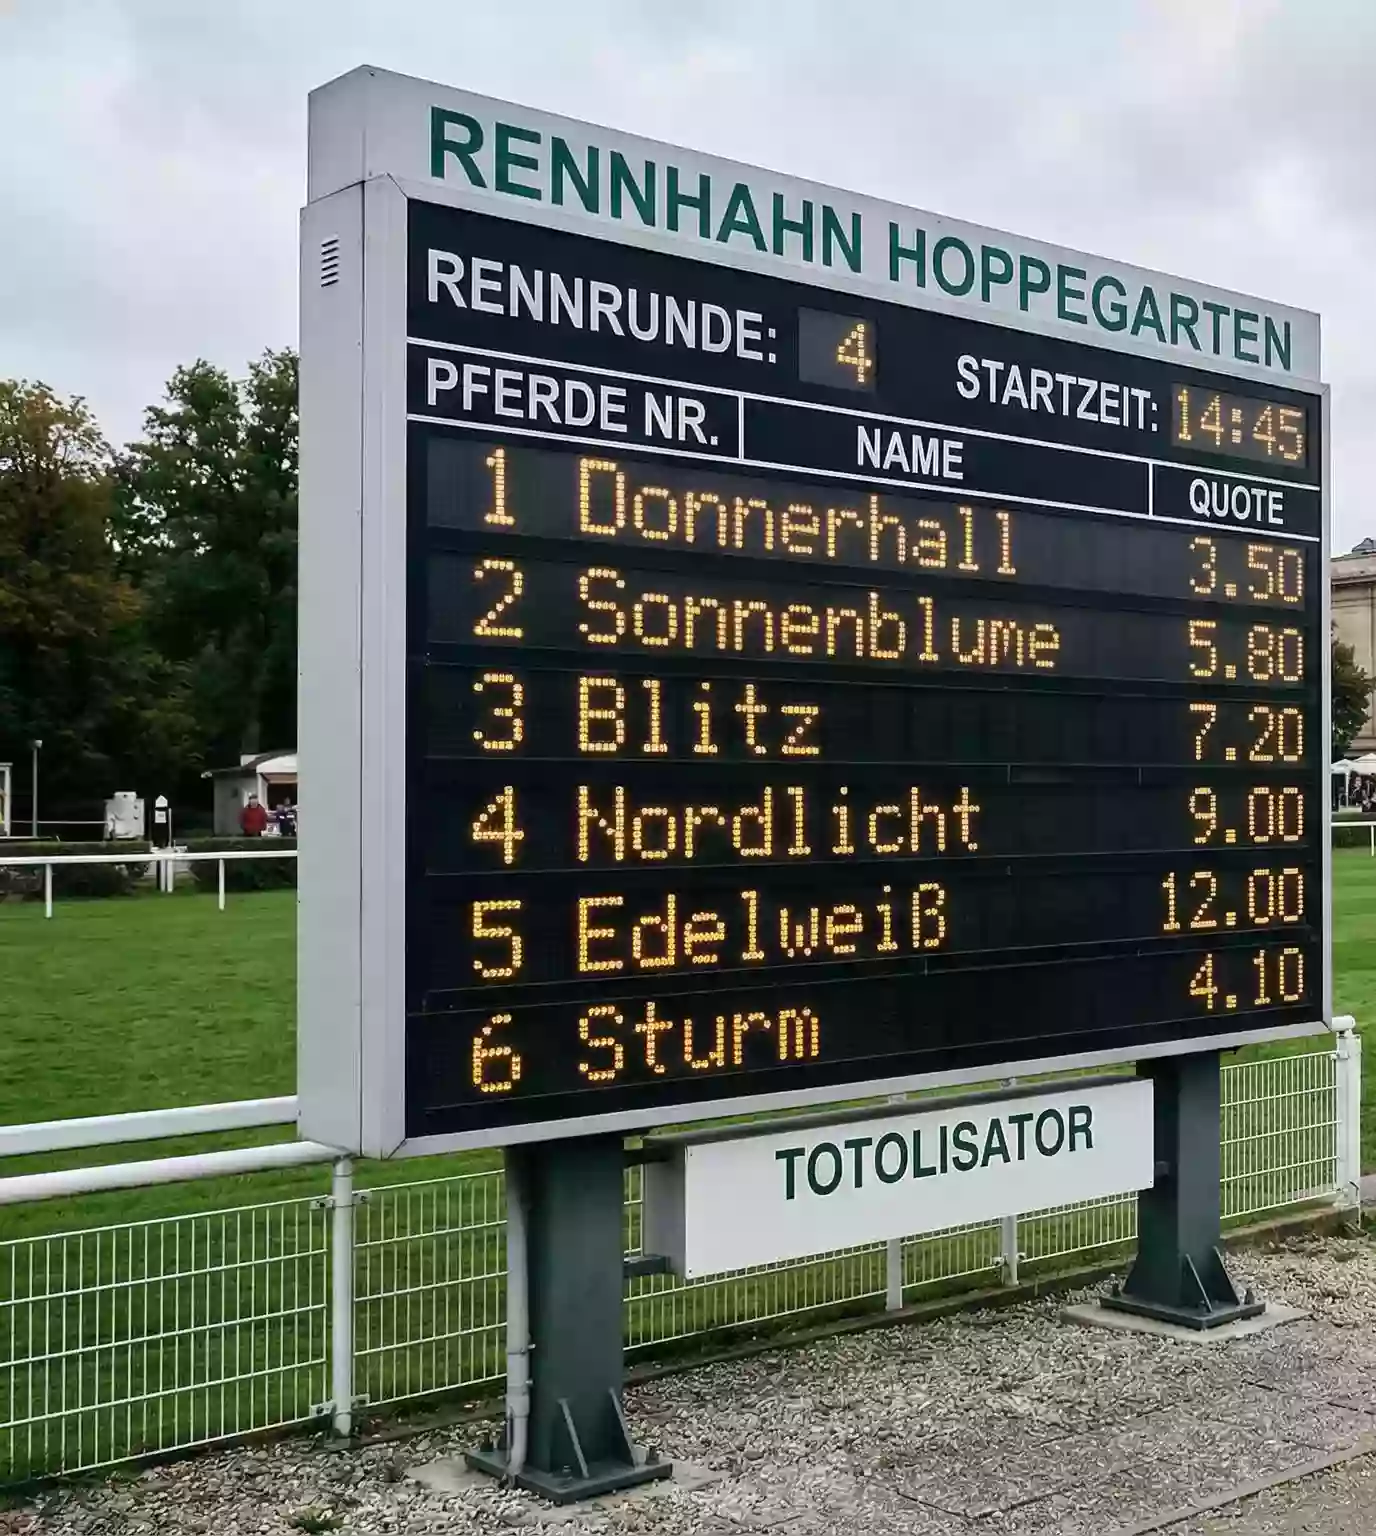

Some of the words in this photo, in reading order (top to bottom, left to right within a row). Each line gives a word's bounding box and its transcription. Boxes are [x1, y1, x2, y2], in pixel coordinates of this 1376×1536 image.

[431, 106, 862, 273] RENNHAHN
[889, 222, 1291, 371] HOPPEGARTEN
[428, 249, 776, 363] RENNRUNDE:
[836, 323, 872, 384] 4
[956, 354, 1158, 432] STARTZEIT:
[427, 358, 627, 433] PFERDE
[644, 392, 718, 446] NR.
[1177, 388, 1304, 461] 14:45
[856, 426, 964, 480] NAME
[485, 447, 516, 526] 1
[579, 458, 1016, 575] Donnerhall
[1189, 536, 1304, 603] 3.50
[1189, 478, 1284, 525] QUOTE
[473, 559, 523, 638] 2
[579, 567, 1060, 668] Sonnenblume
[1189, 620, 1304, 682] 5.80
[473, 673, 523, 750] 3
[579, 676, 820, 755] Blitz
[1188, 703, 1305, 762] 7.20
[472, 785, 524, 864] 4
[578, 786, 981, 863] Nordlicht
[1188, 787, 1304, 844] 9.00
[472, 900, 522, 978] 5
[578, 883, 948, 972] Edelweiß
[1161, 867, 1304, 930] 12.00
[472, 1014, 521, 1093] 6
[579, 1002, 820, 1081] Sturm
[1188, 947, 1304, 1009] 4.10
[776, 1105, 1093, 1200] TOTOLISATOR
